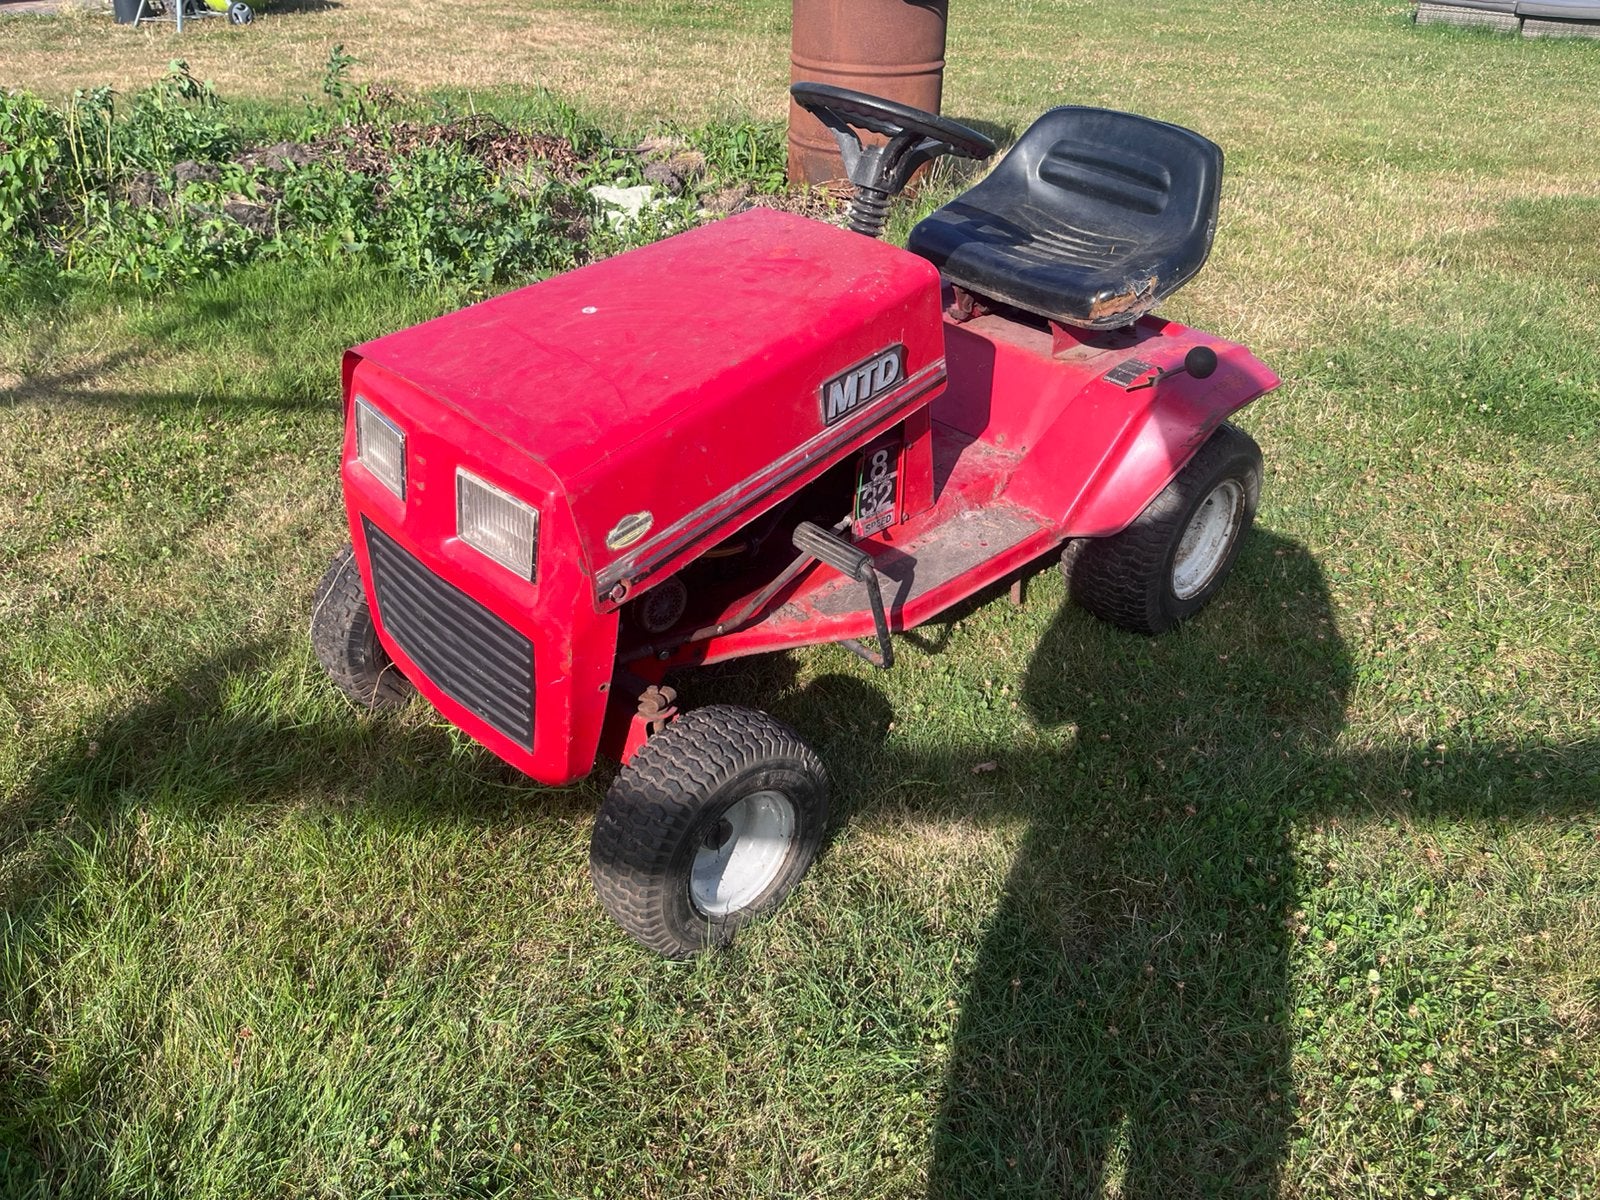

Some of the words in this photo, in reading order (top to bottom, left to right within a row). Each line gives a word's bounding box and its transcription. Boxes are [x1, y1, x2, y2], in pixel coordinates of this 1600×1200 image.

[827, 353, 899, 419] MTD
[870, 449, 888, 482] 8
[860, 479, 893, 516] 32
